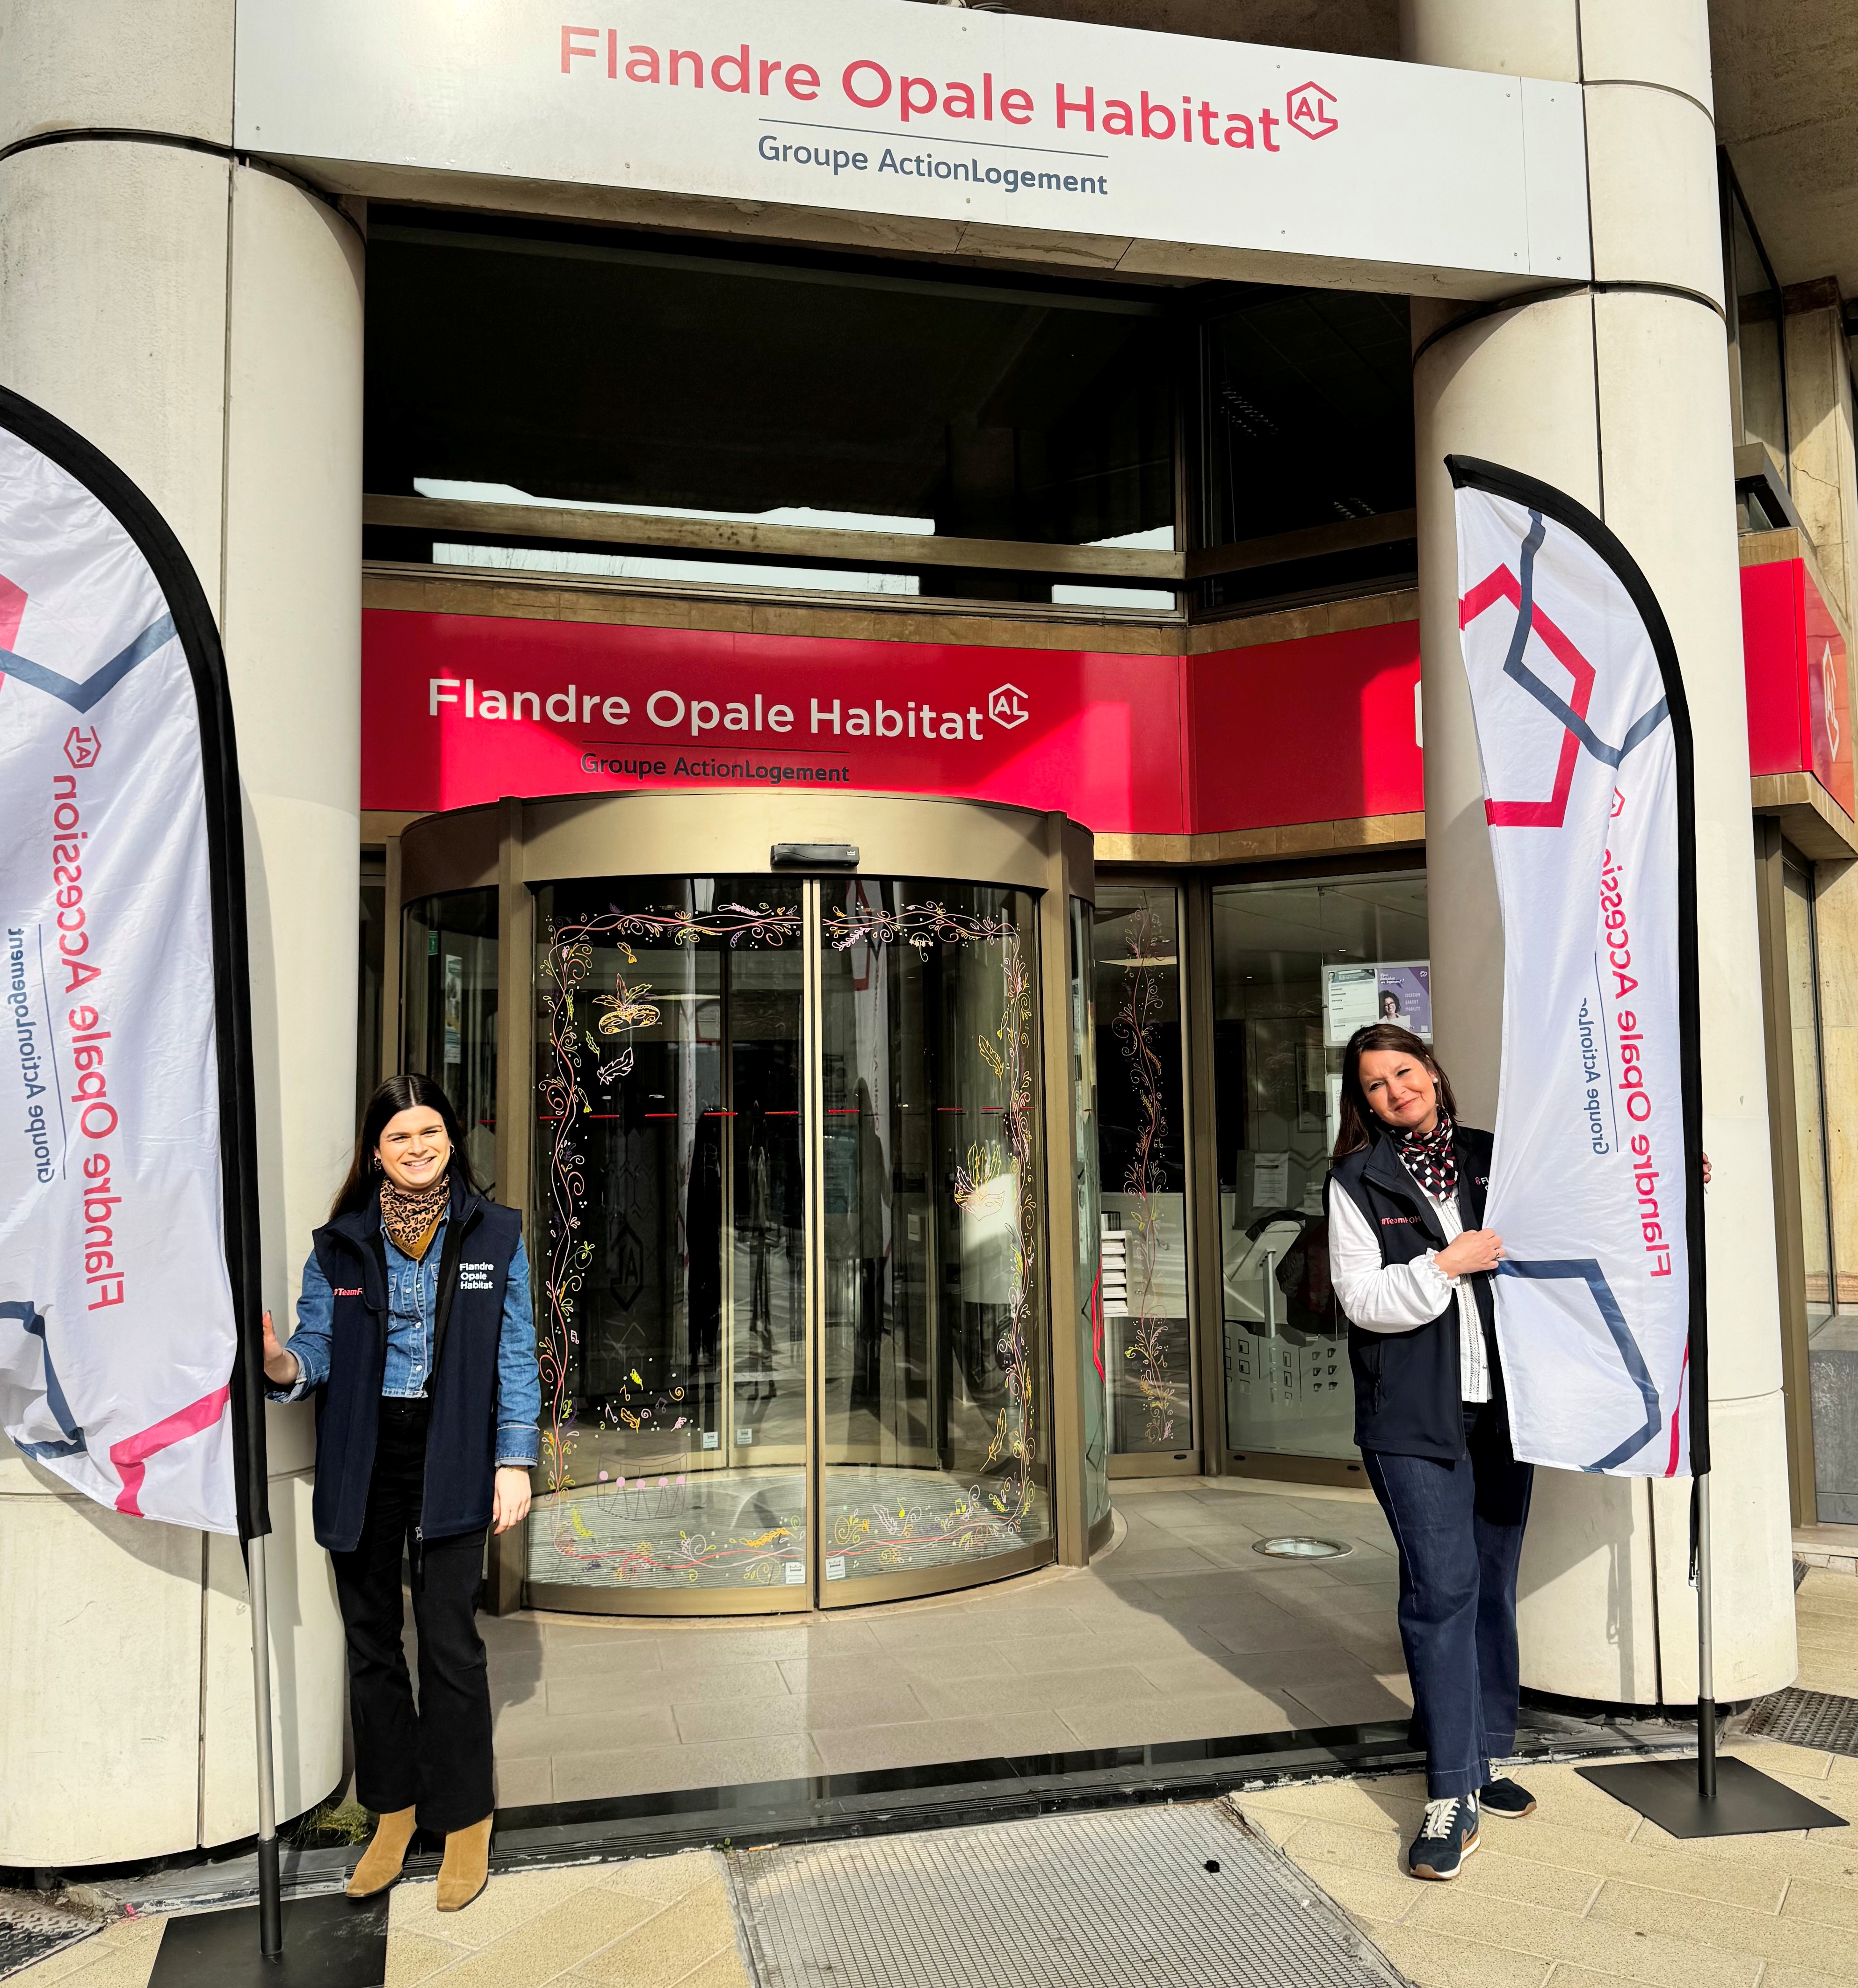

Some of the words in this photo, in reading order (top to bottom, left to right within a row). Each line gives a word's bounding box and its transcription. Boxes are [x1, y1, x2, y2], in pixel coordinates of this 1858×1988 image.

[560, 25, 821, 101] Flandre
[842, 59, 1034, 123] Opale
[1055, 82, 1280, 153] Habitat
[758, 135, 868, 175] Groupe
[877, 148, 1108, 195] ActionLogement
[429, 678, 631, 725] Flandre
[646, 690, 795, 737] Opale
[810, 698, 983, 741] Habitat
[581, 752, 666, 780] Groupe
[673, 757, 850, 784] ActionLogement
[459, 1262, 494, 1271] Flandre
[460, 1271, 487, 1281] Opale
[333, 1287, 363, 1296] #TeamF
[460, 1280, 493, 1289] Habitat
